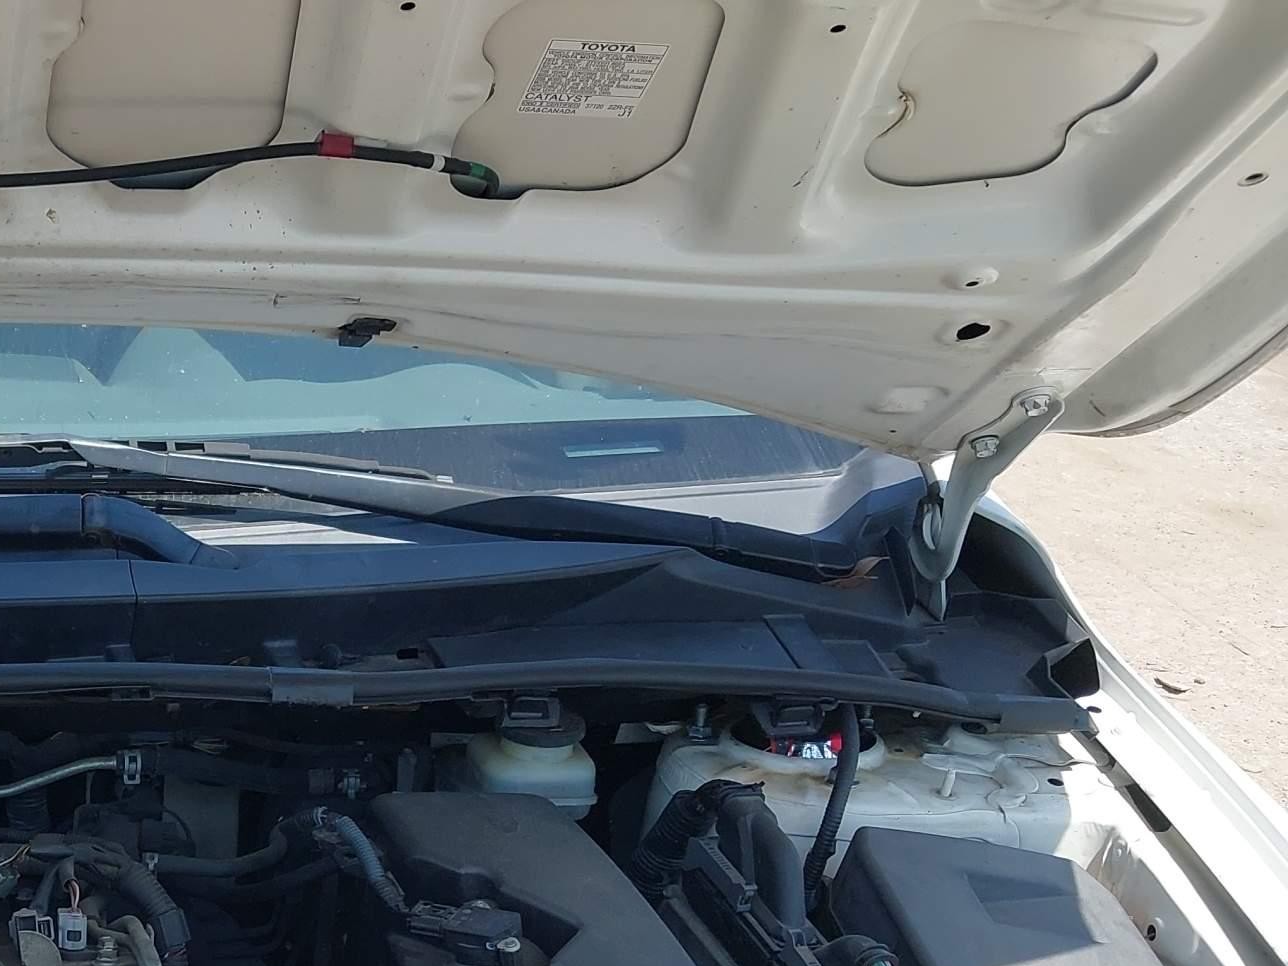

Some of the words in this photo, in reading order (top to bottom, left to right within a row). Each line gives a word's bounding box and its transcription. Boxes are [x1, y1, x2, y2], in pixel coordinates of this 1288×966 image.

[581, 43, 636, 53] TOYOTA
[524, 92, 592, 103] CATALYST
[518, 107, 576, 115] USA&CANADA
